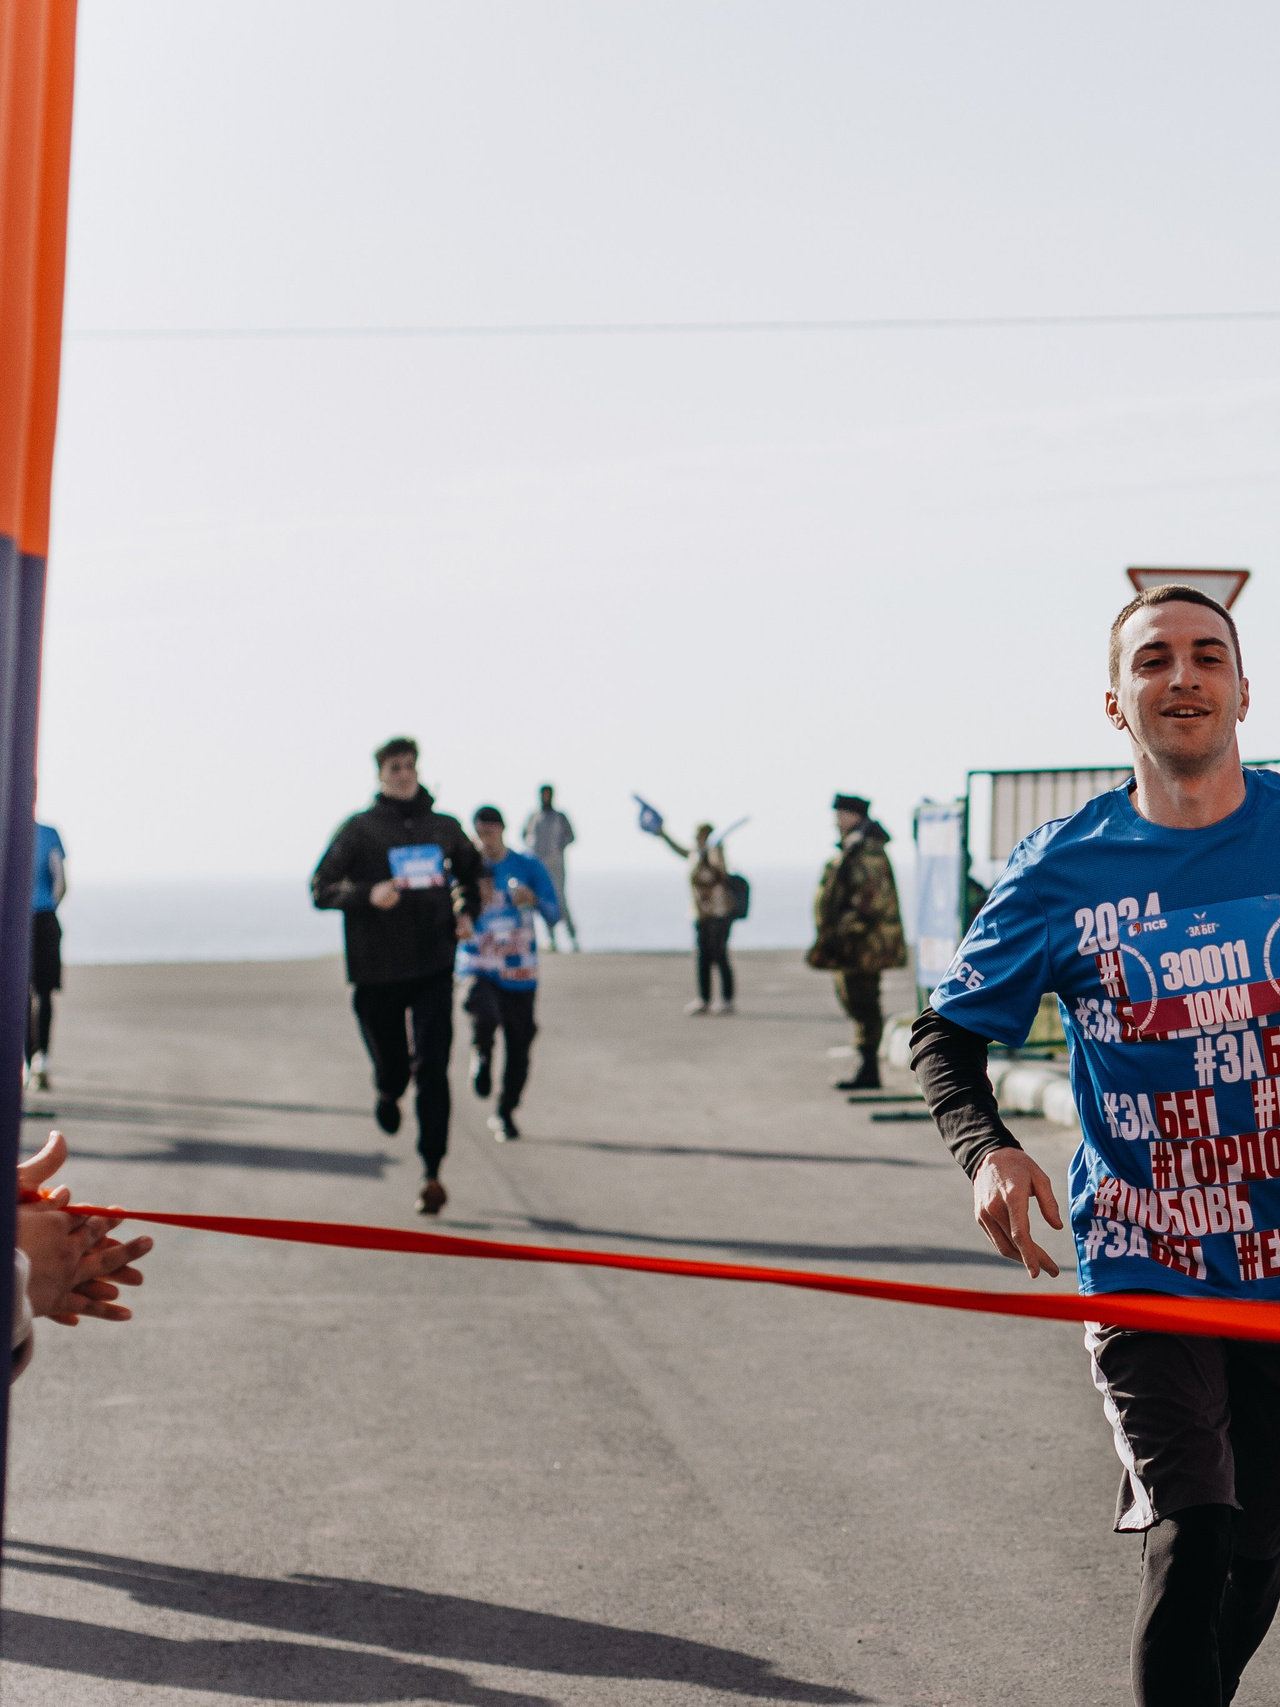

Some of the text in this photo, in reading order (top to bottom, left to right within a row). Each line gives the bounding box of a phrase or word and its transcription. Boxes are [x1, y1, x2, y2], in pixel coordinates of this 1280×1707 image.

[1143, 918, 1168, 932] ПСБ
[1159, 939, 1251, 991] 30011
[1182, 984, 1254, 1028] 10КМ
[1103, 1088, 1216, 1141] #ЗАБЕГ
[1094, 1176, 1254, 1237] #ЛЮБОВЬ
[1084, 1218, 1205, 1279] #ЗАБЕГ
